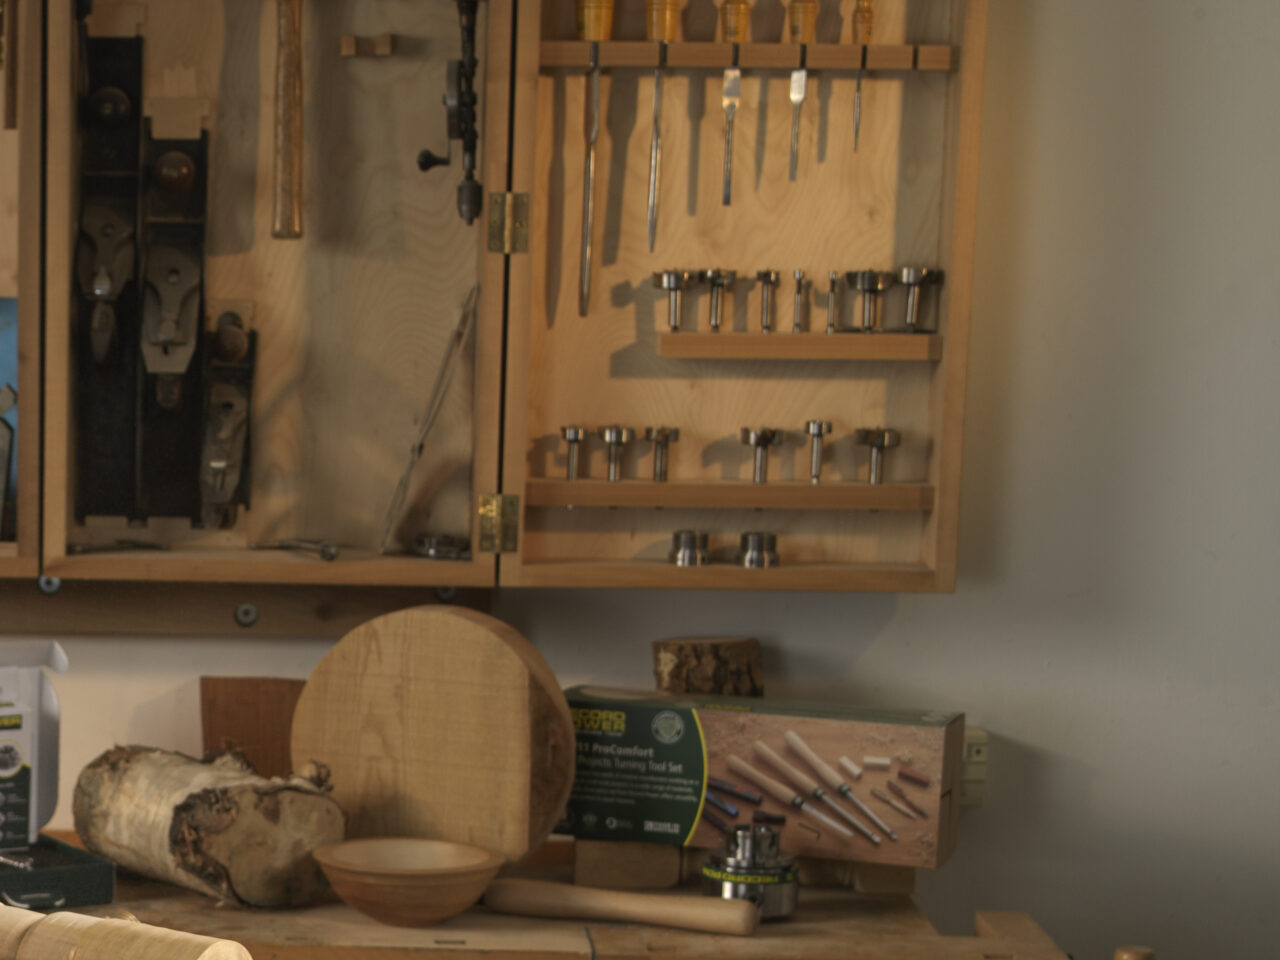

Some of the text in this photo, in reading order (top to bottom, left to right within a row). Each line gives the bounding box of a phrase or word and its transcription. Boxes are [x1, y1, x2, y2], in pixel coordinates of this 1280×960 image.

[573, 718, 626, 732] OWER
[592, 743, 654, 757] ProComfort
[648, 760, 666, 772] Tool
[668, 762, 683, 774] Set
